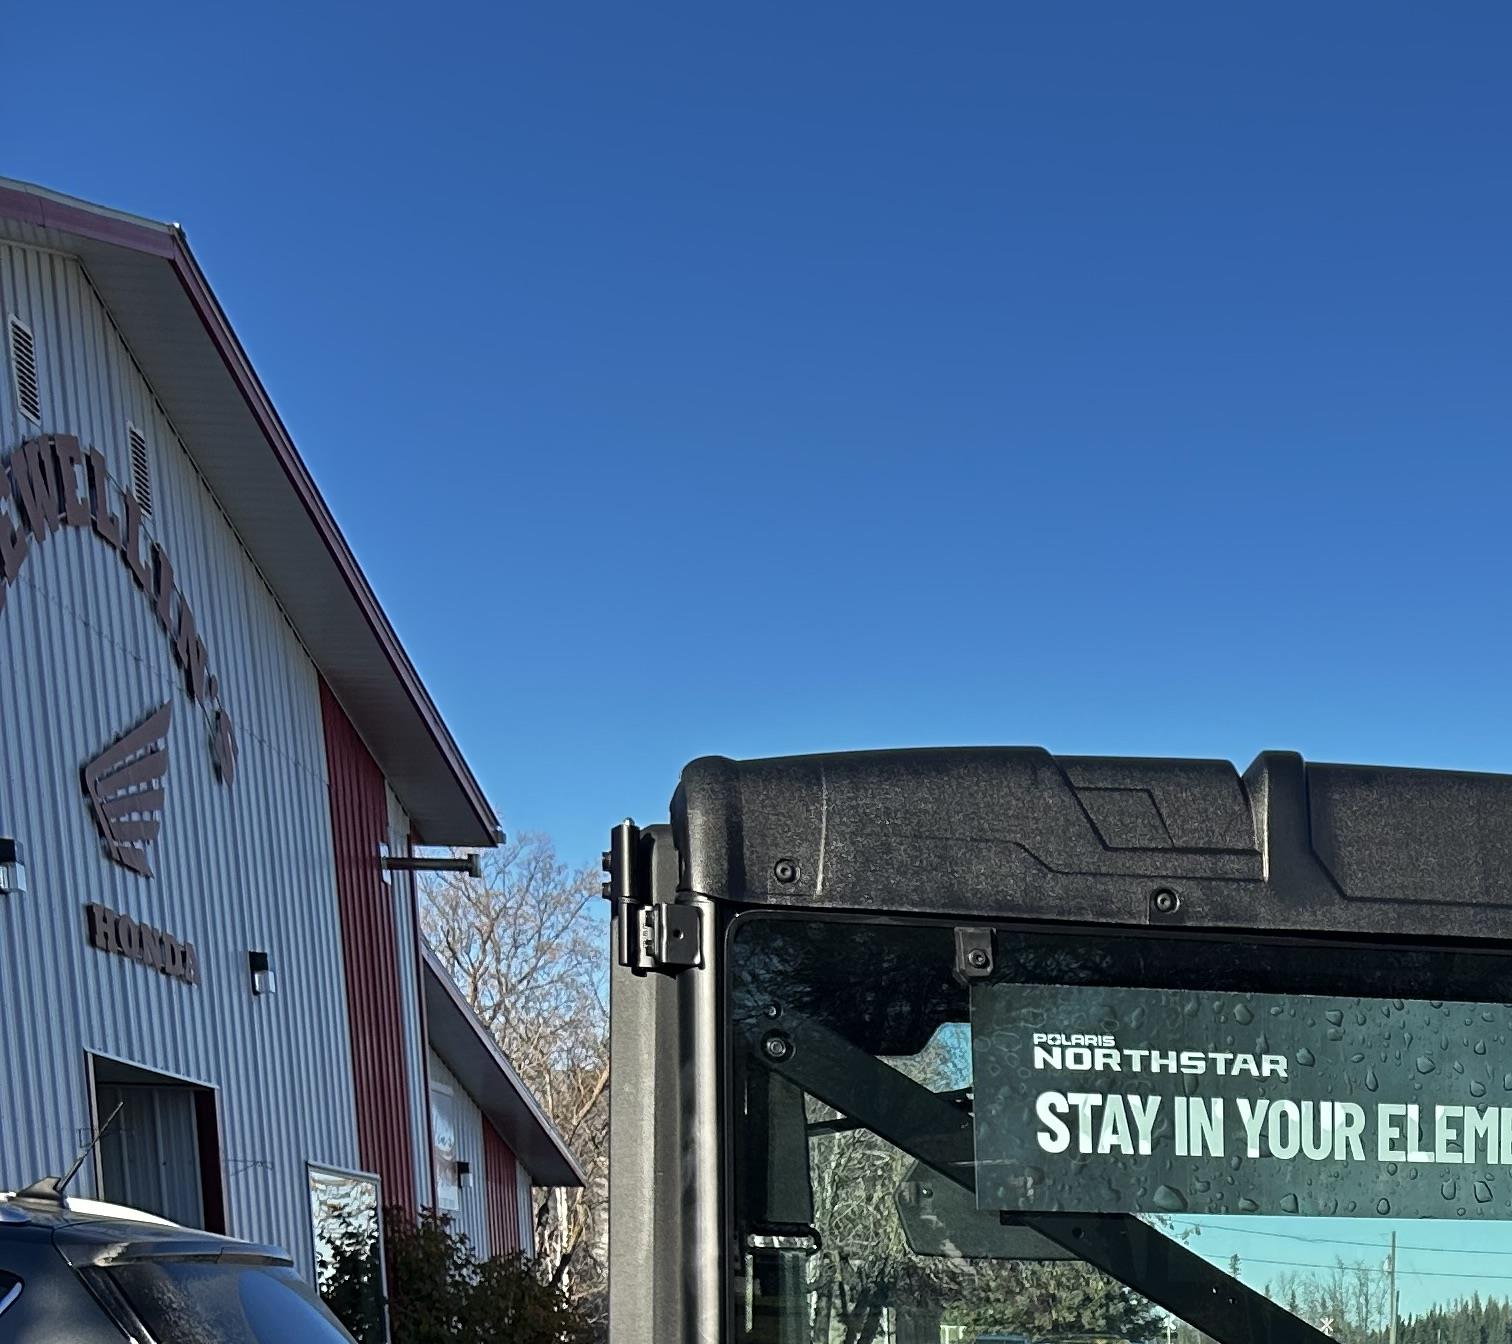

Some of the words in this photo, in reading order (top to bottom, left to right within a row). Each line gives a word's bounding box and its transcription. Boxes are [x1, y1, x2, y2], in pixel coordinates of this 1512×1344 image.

[88, 901, 200, 986] HONDA
[1033, 1033, 1116, 1047] POLARIS
[1033, 1046, 1289, 1078] NORTHSTAR
[1035, 1091, 1162, 1156] STAY
[1174, 1095, 1225, 1158] IN
[1235, 1098, 1366, 1162] YOUR
